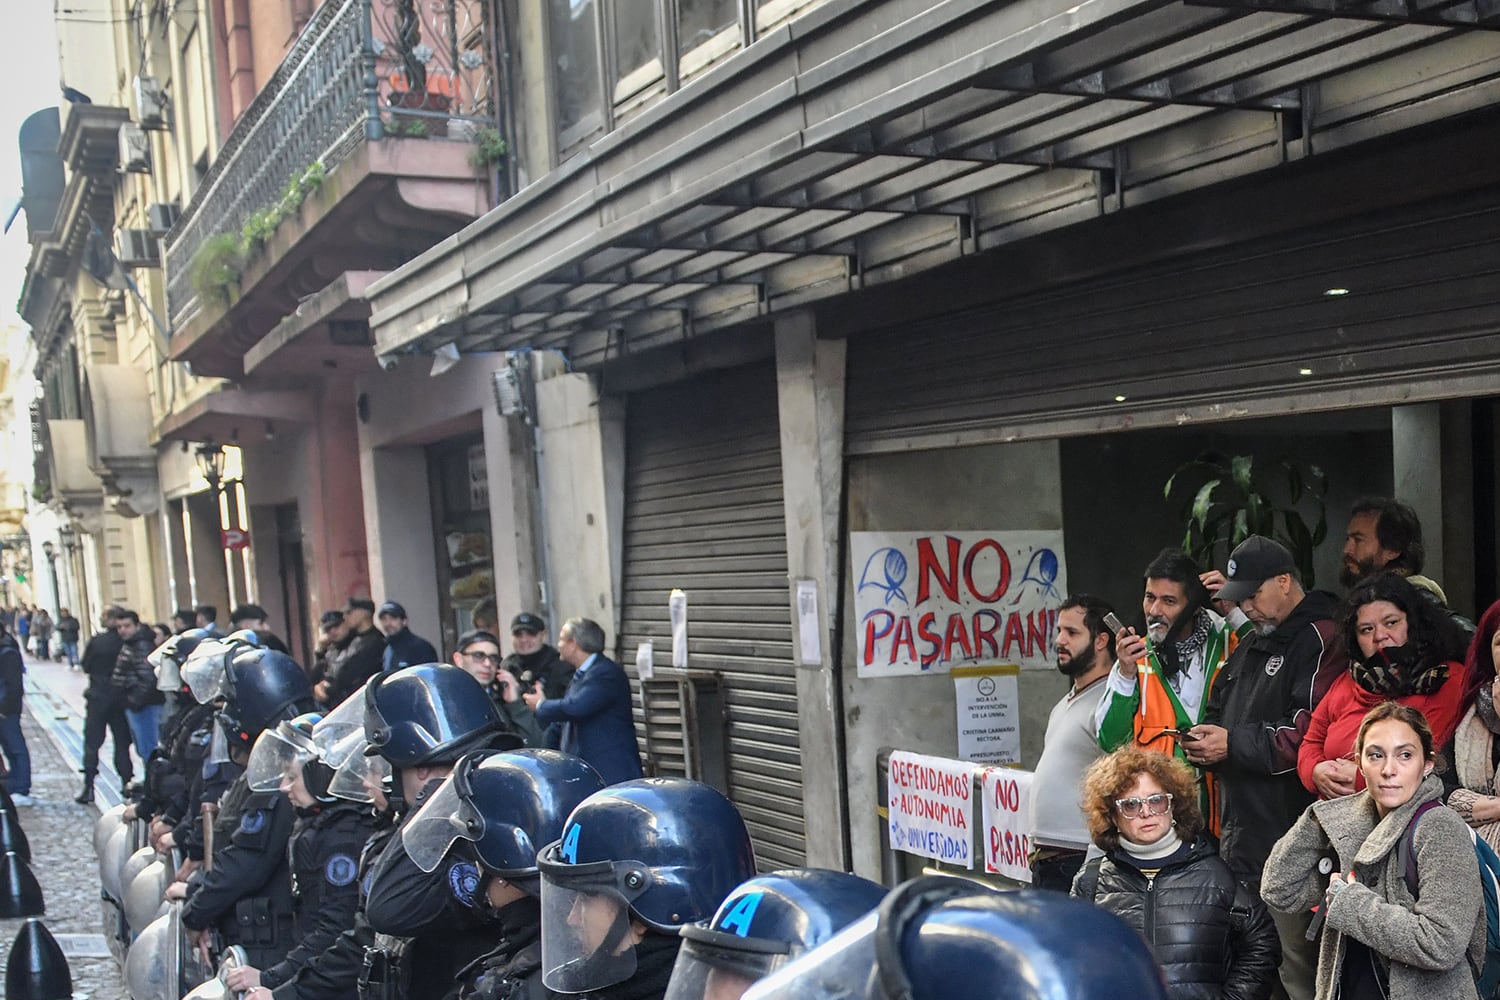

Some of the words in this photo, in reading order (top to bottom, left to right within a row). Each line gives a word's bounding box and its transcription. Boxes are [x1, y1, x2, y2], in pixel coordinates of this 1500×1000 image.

[915, 534, 1012, 608] NO
[891, 760, 969, 800] DEFENDAMOS
[995, 779, 1020, 812] NO
[900, 794, 967, 829] AUTONOMIA
